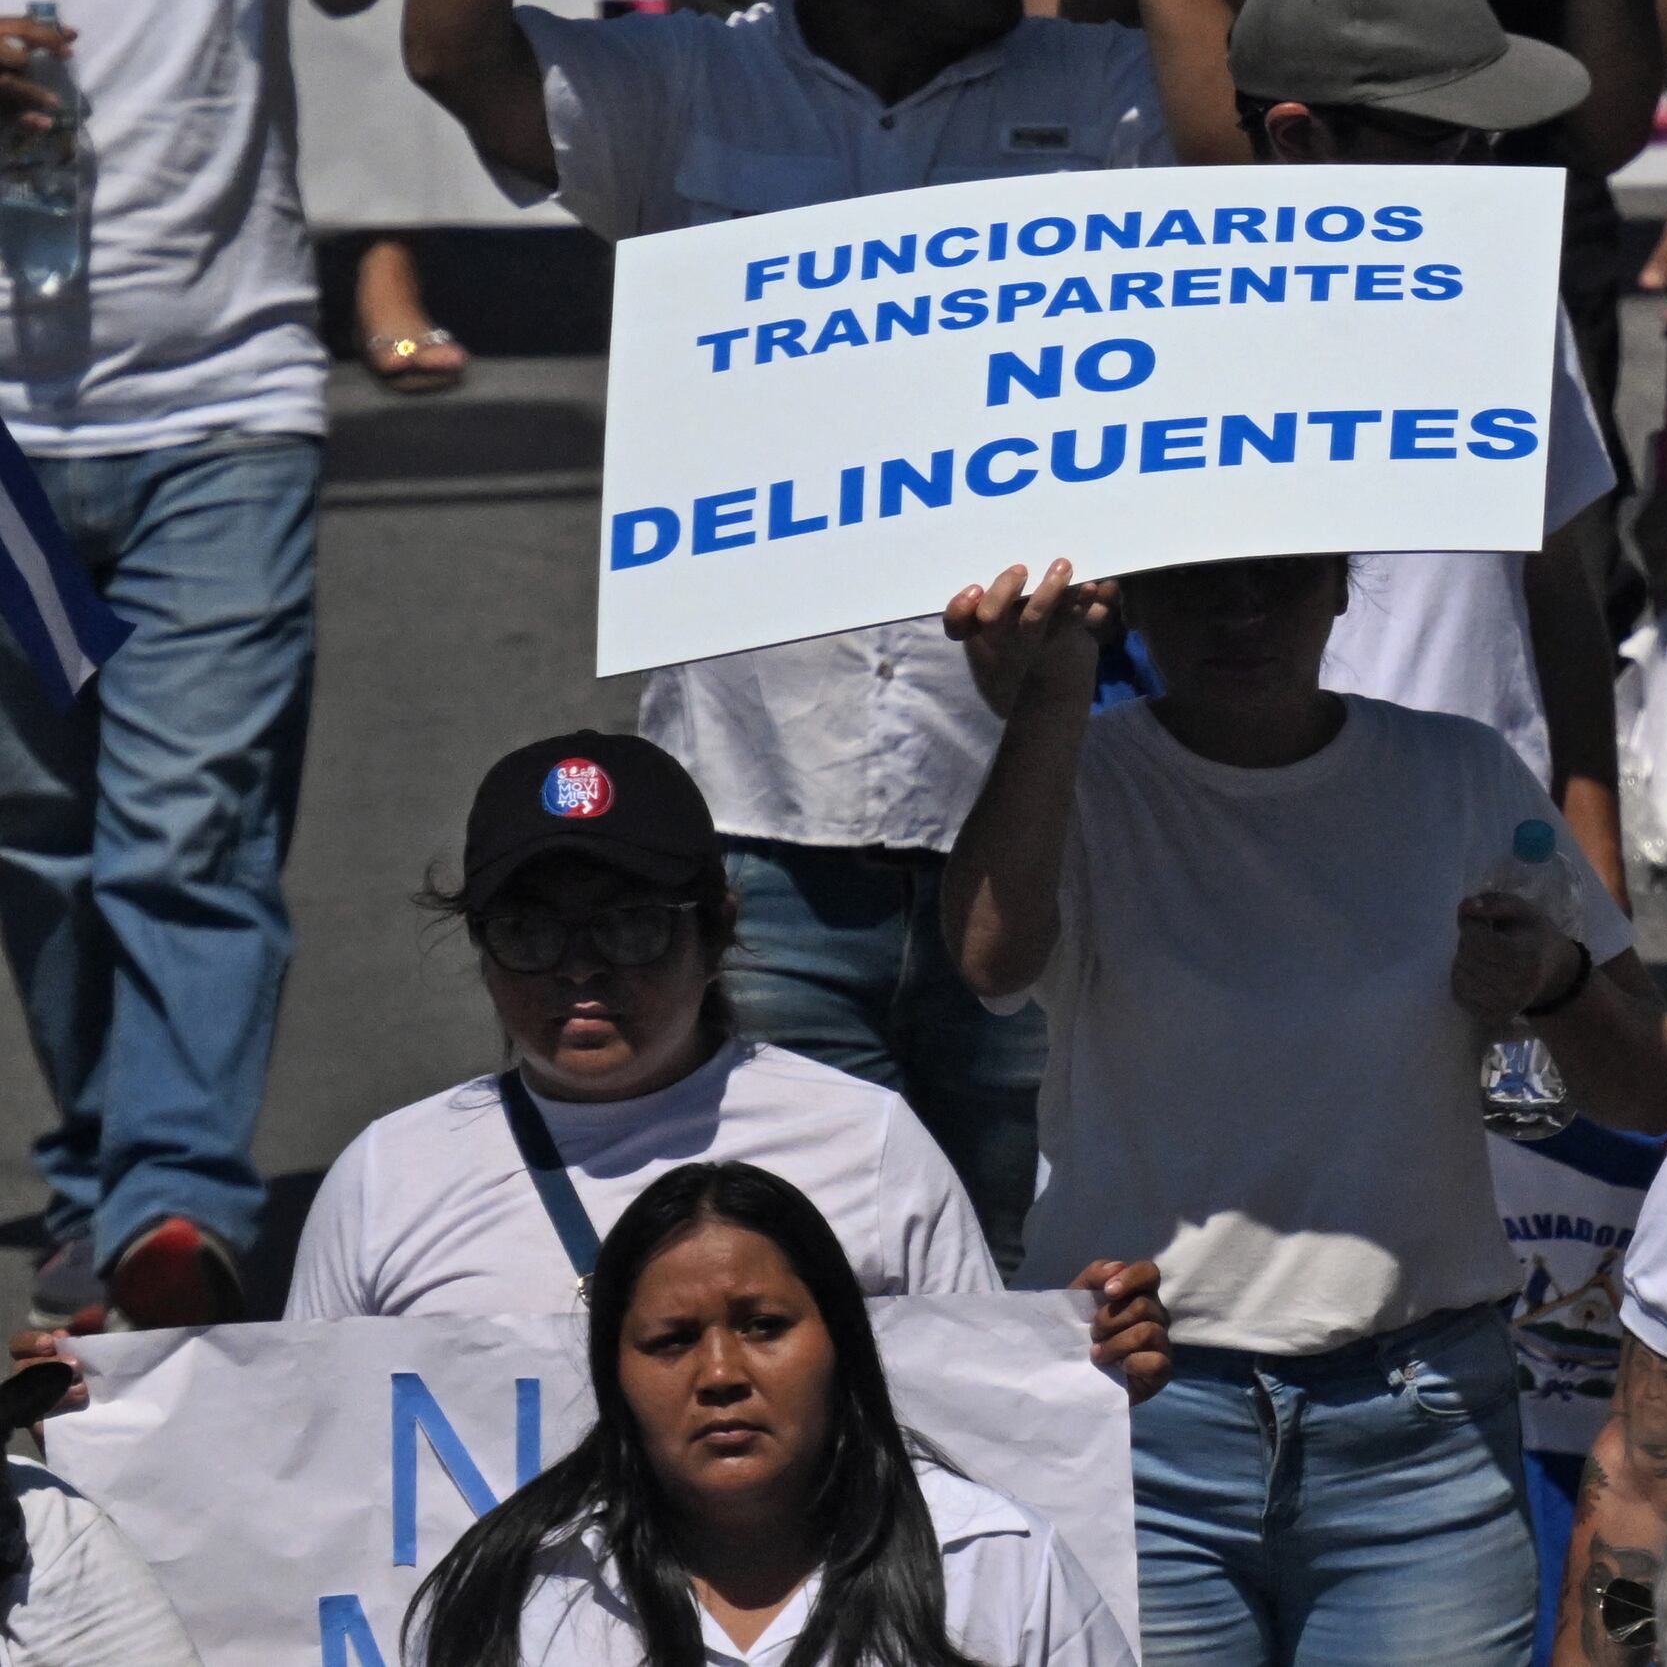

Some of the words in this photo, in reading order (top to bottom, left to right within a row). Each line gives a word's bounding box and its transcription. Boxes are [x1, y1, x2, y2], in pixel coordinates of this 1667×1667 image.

[744, 205, 1425, 302] FUNCIONARIOS
[697, 263, 1465, 374] TRANSPARENTES
[985, 337, 1157, 407] NO
[609, 407, 1540, 572] DELINCUENTES
